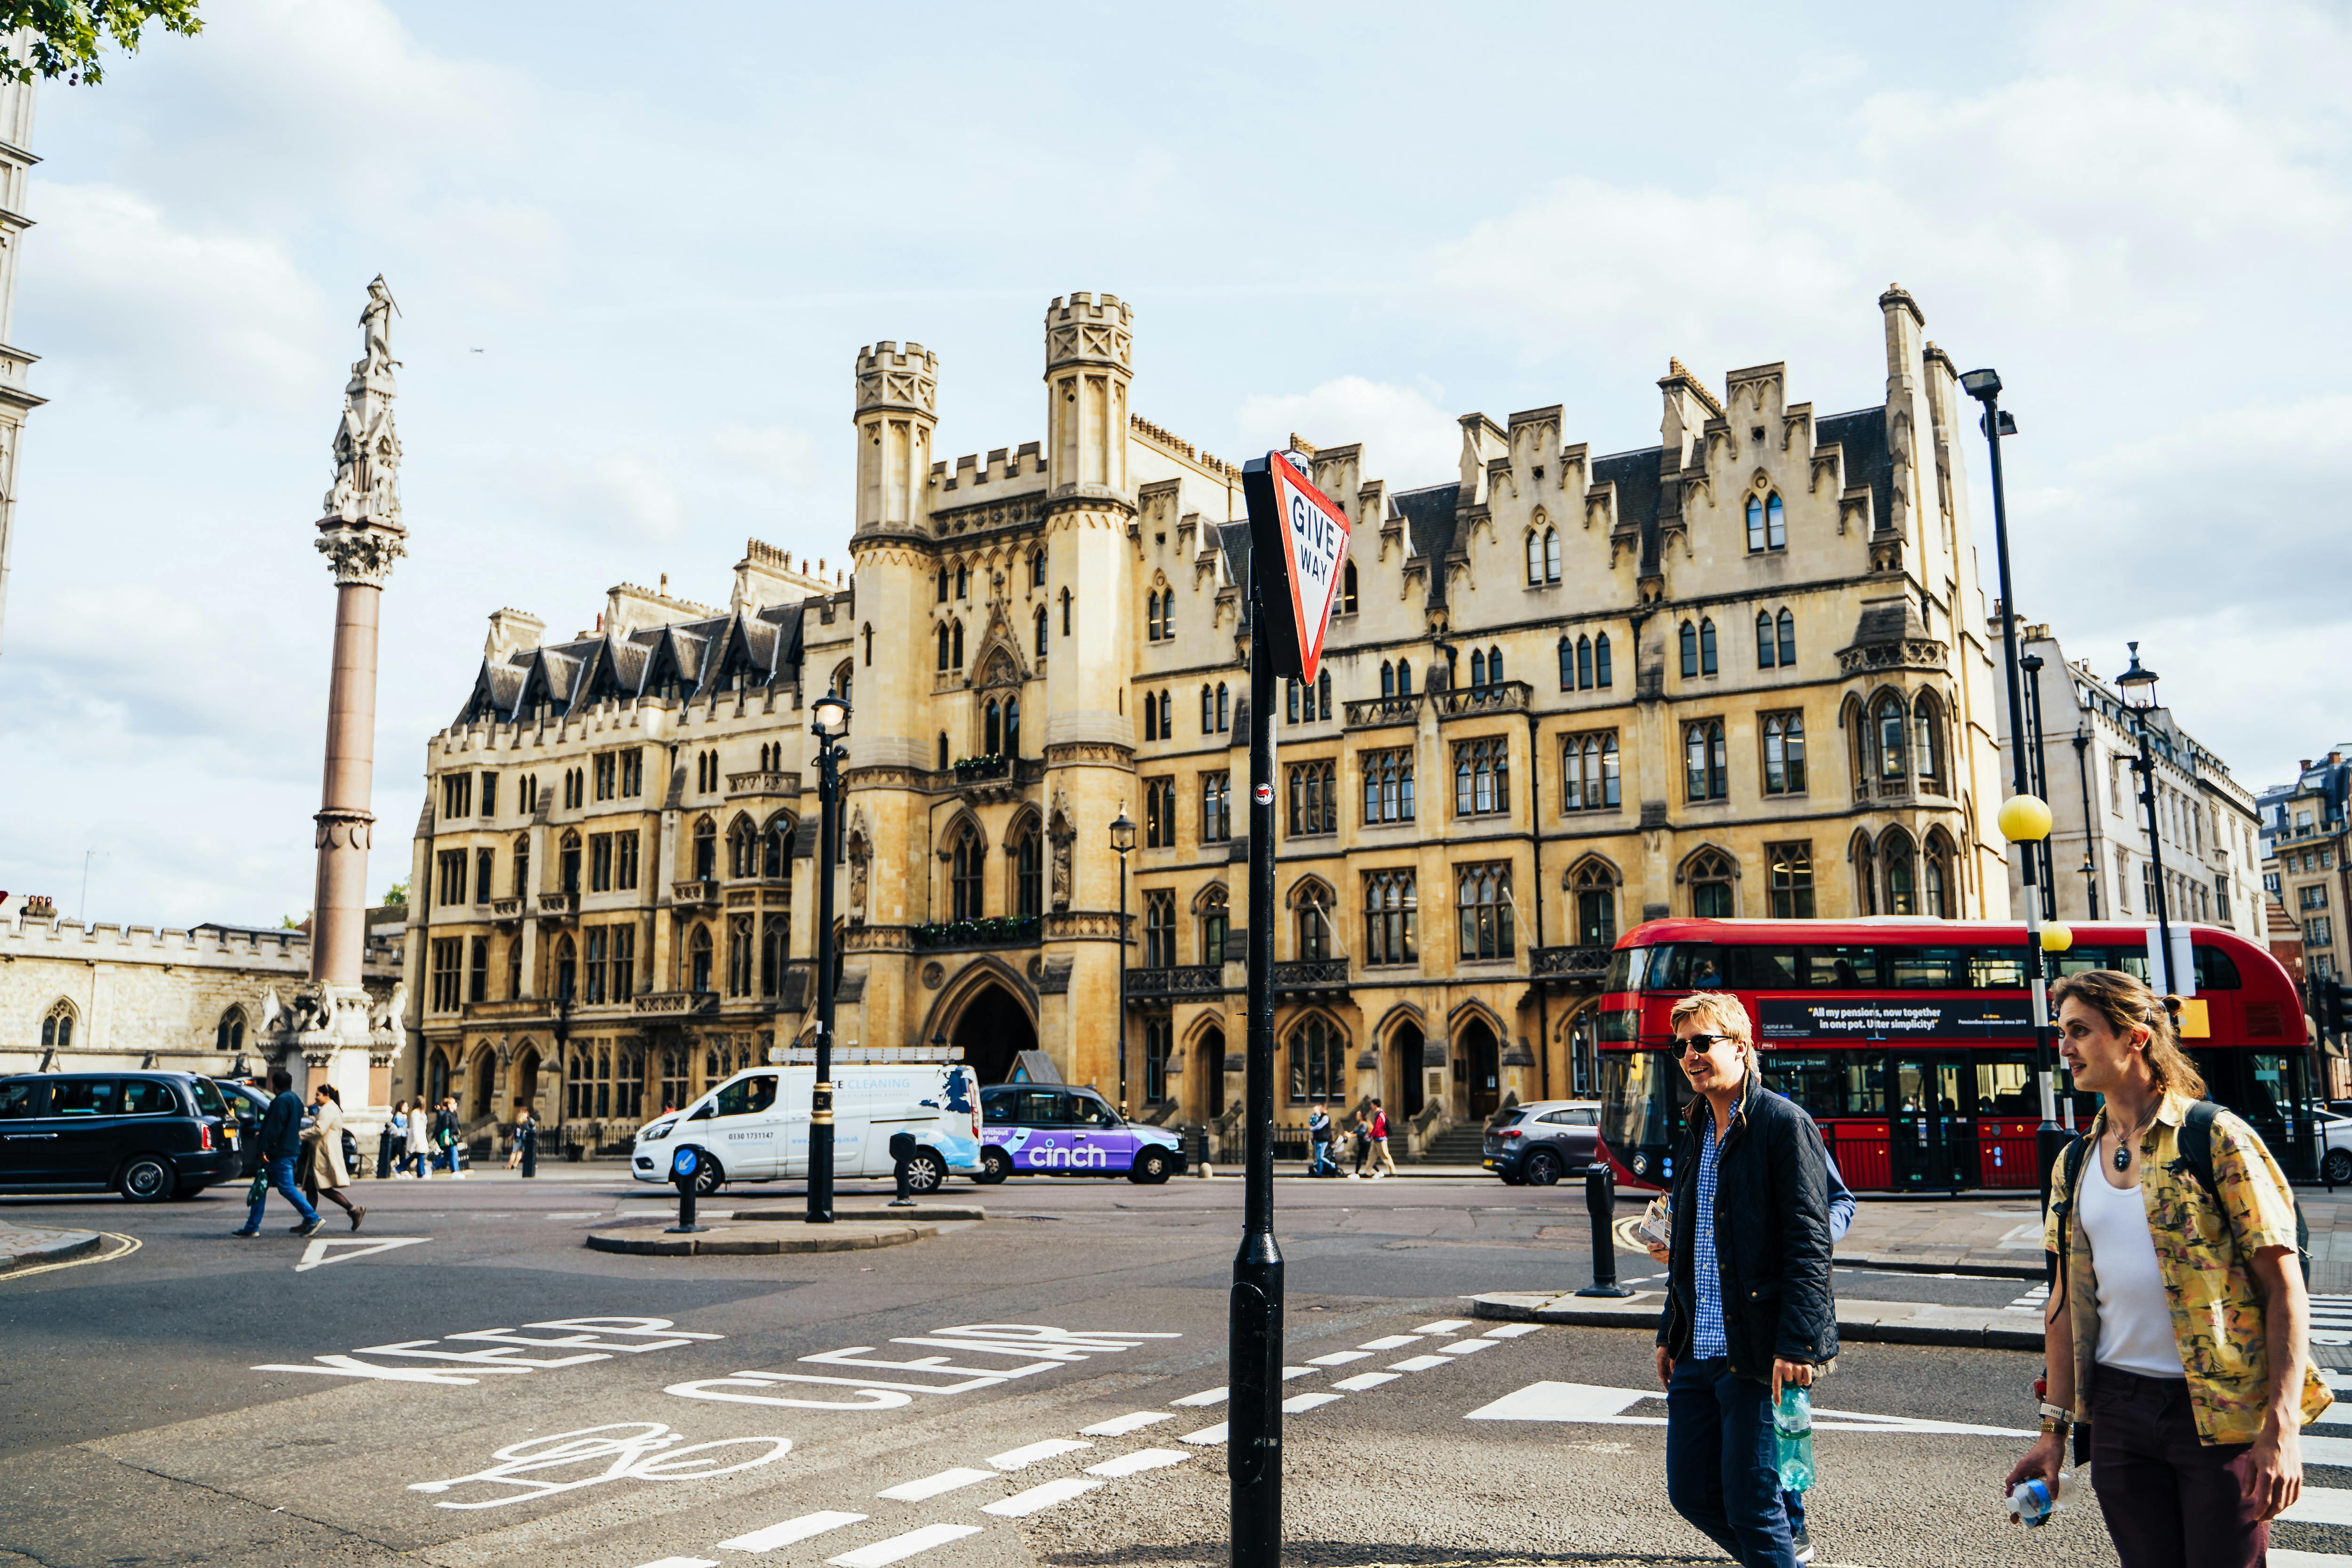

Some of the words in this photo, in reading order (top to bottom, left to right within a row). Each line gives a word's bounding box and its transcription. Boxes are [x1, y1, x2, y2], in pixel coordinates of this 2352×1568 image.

[1293, 495, 1334, 561] GIVE
[1301, 544, 1327, 586] WAY
[1820, 1019, 1829, 1029] in
[1847, 1019, 1866, 1031] pot.
[1826, 1009, 1840, 1019] my
[1841, 1007, 1882, 1019] pensions,
[1903, 1007, 1941, 1019] together
[848, 1078, 910, 1089] CLEANING
[1029, 1138, 1106, 1167] cinch
[250, 1317, 725, 1385] KEEP
[663, 1323, 1182, 1409] CLEAR
